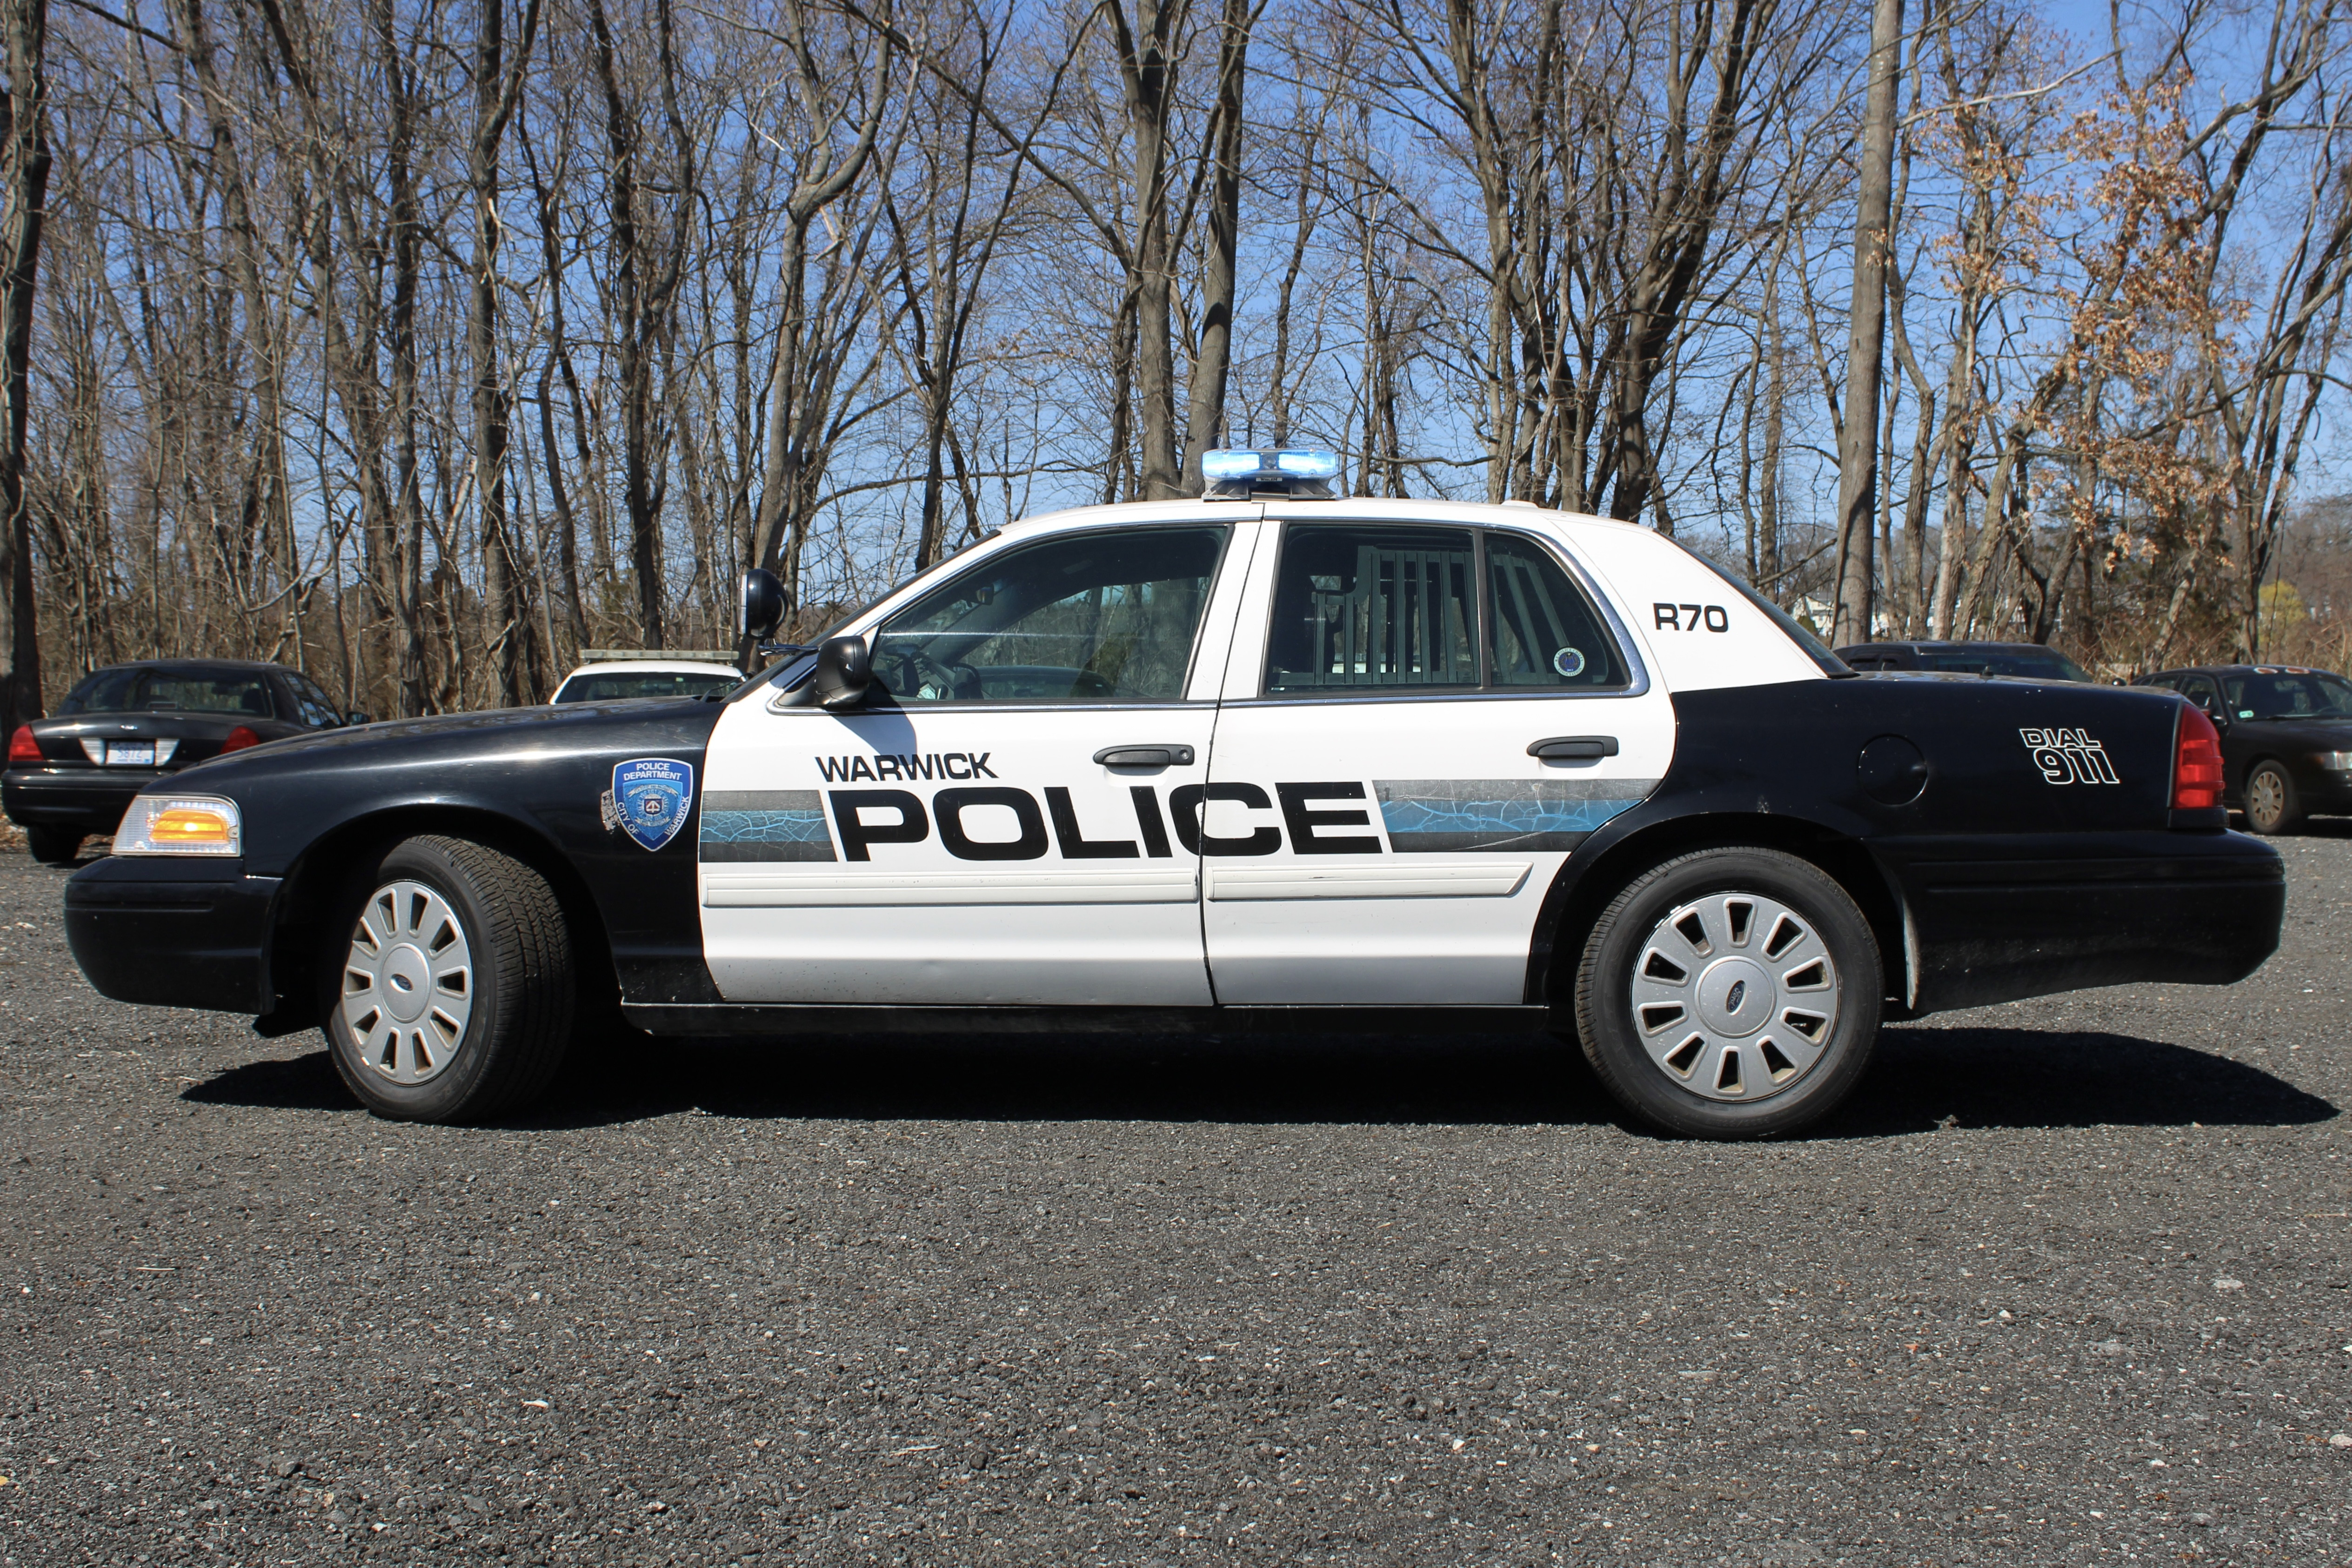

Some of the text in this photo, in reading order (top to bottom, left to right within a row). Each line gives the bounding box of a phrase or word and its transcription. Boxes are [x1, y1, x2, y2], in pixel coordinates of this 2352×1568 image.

[1653, 603, 1729, 633] R70
[2019, 728, 2102, 748] DIAL
[623, 771, 682, 781] DEPARTMENT
[815, 752, 999, 783] WARWICK
[2033, 747, 2120, 785] 911
[617, 802, 630, 821] CITY
[628, 823, 639, 835] OF
[664, 796, 689, 836] WARWICK
[835, 781, 1383, 862] POLICE
